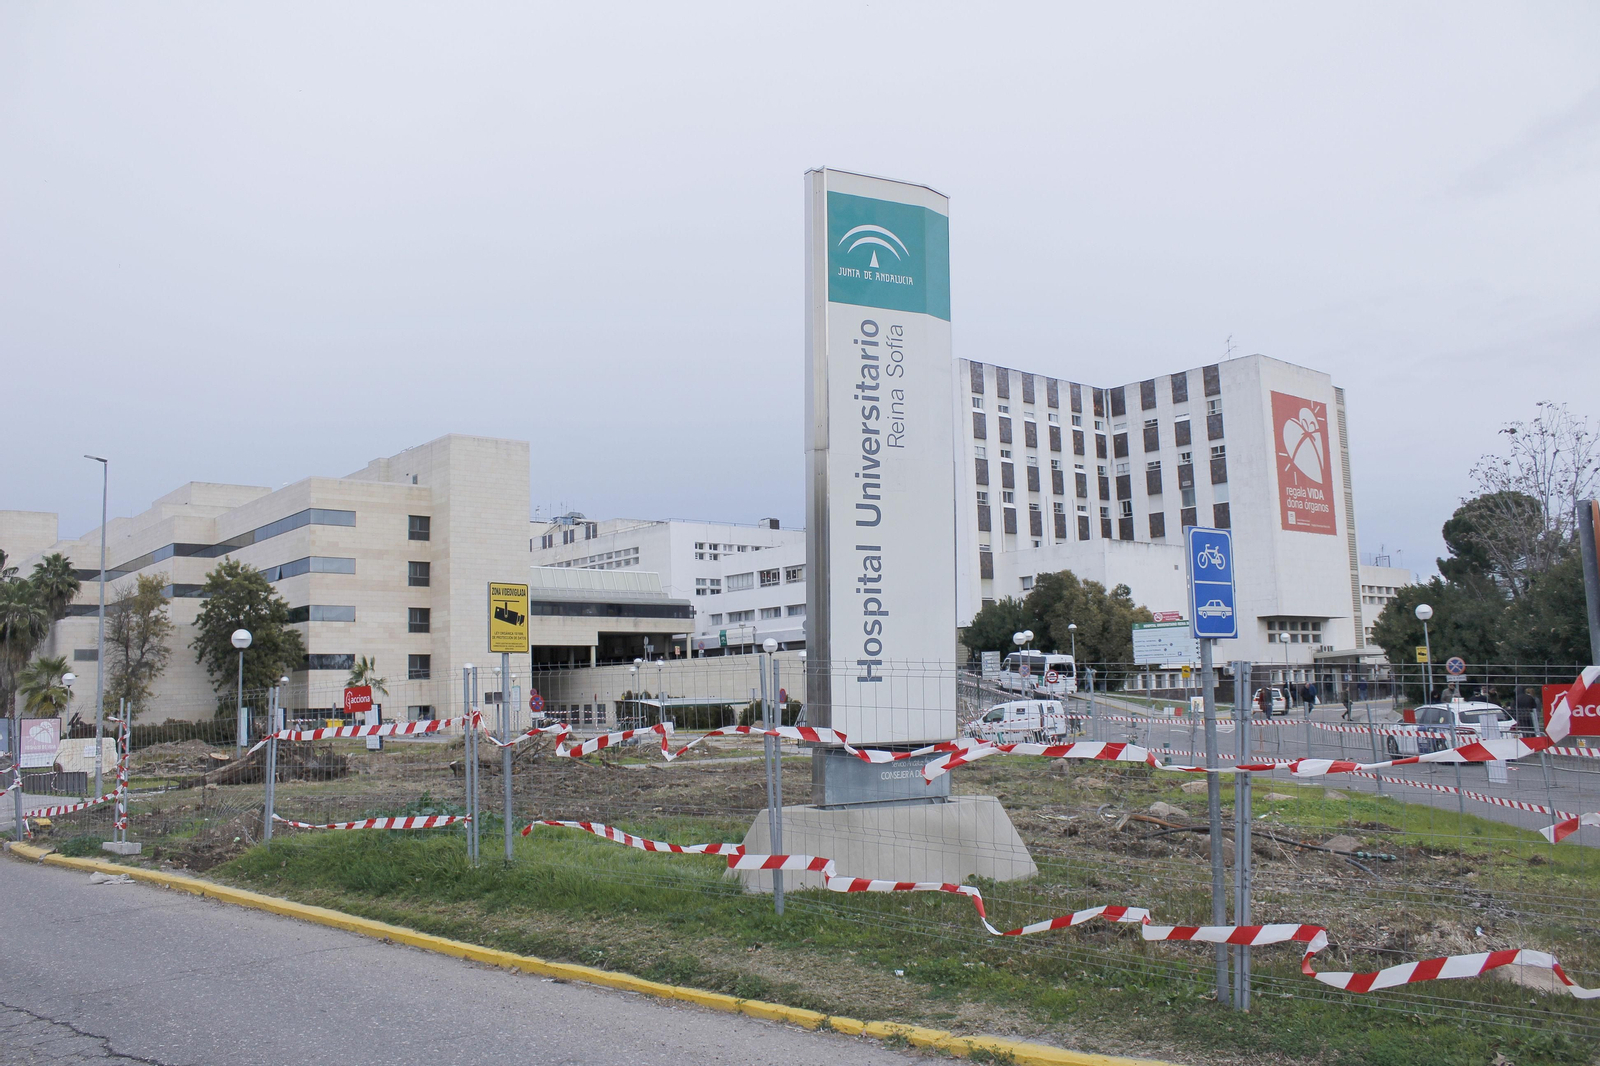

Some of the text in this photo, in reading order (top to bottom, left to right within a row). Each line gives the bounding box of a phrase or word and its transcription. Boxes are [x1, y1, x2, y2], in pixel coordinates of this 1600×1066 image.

[838, 266, 860, 279] JUNTA
[863, 270, 873, 281] DE
[885, 323, 905, 448] Reina Sofía
[1286, 486, 1324, 500] regala VIDA
[854, 319, 889, 682] Hospital Universitario
[1287, 497, 1330, 513] dona órganos
[492, 587, 526, 597] ZONA VIDEOVIGILADA
[350, 694, 371, 704] acciona
[880, 768, 914, 780] CONSEJERA
